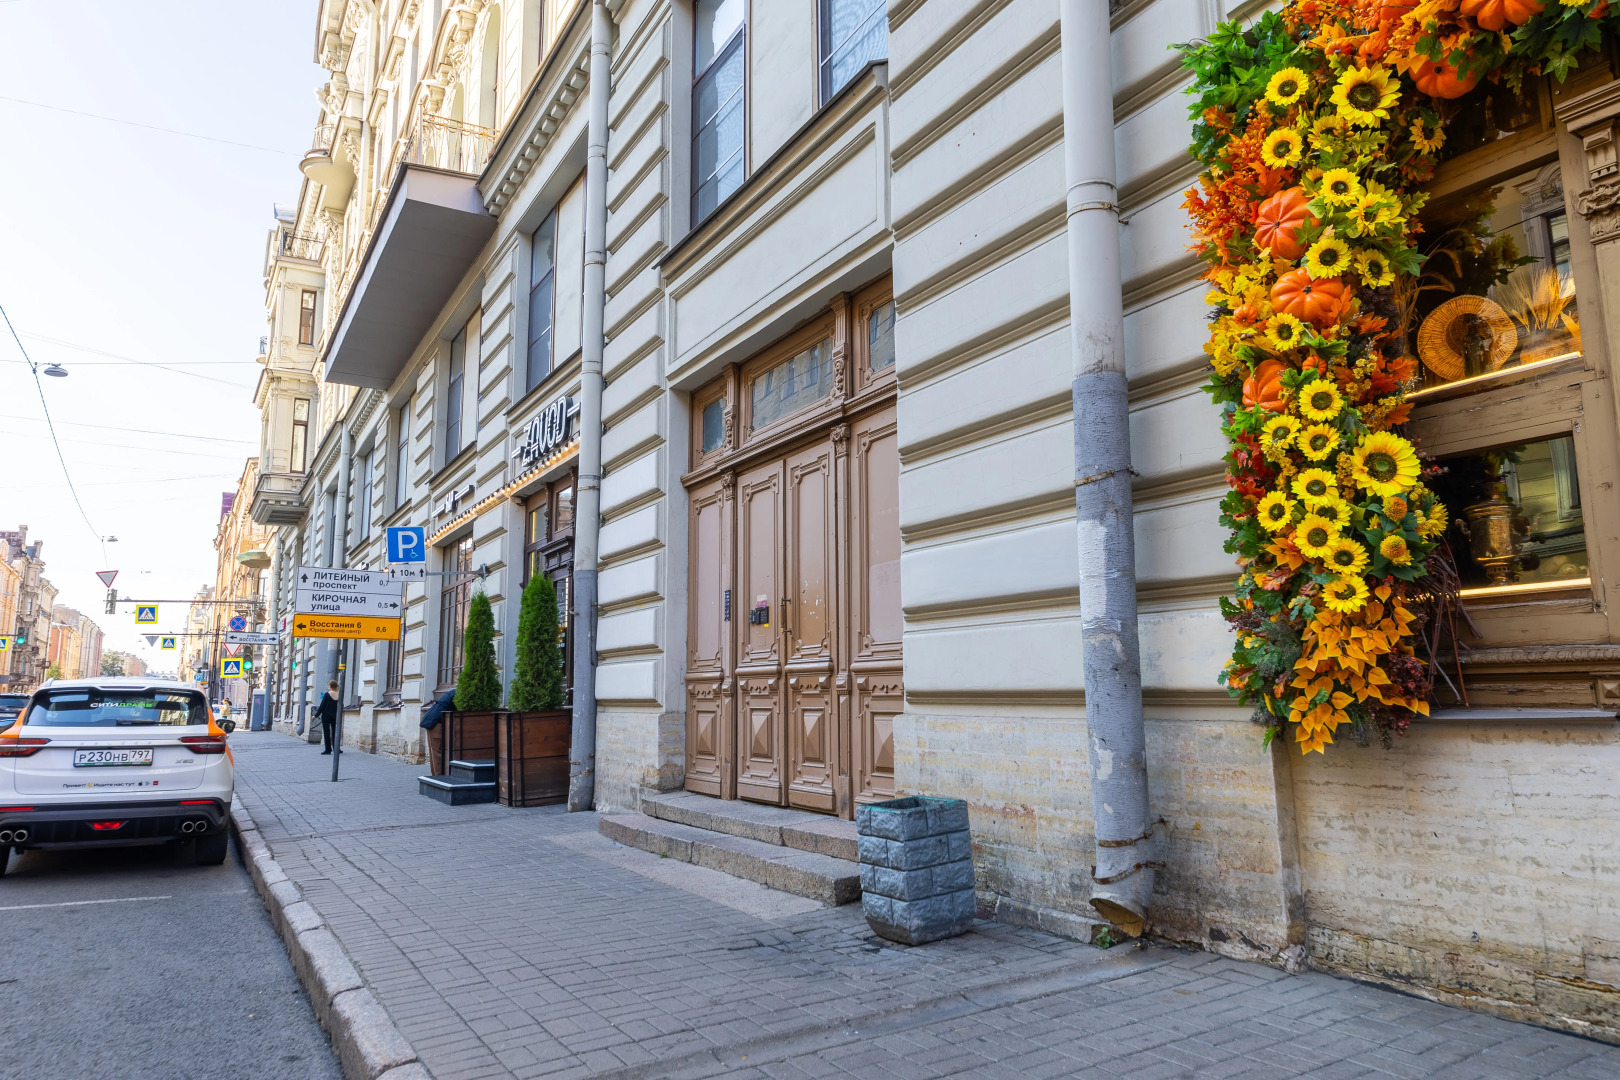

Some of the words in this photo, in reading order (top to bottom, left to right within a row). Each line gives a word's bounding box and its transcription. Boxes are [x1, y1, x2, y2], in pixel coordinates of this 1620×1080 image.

[397, 530, 418, 559] P
[313, 571, 370, 583] ЛИТЕЙНЫЙ
[312, 581, 357, 590] проспект
[311, 593, 367, 604] КИРОЧНАЯ
[310, 603, 341, 612] улица
[309, 620, 355, 629] Восстания
[131, 750, 150, 759] 797
